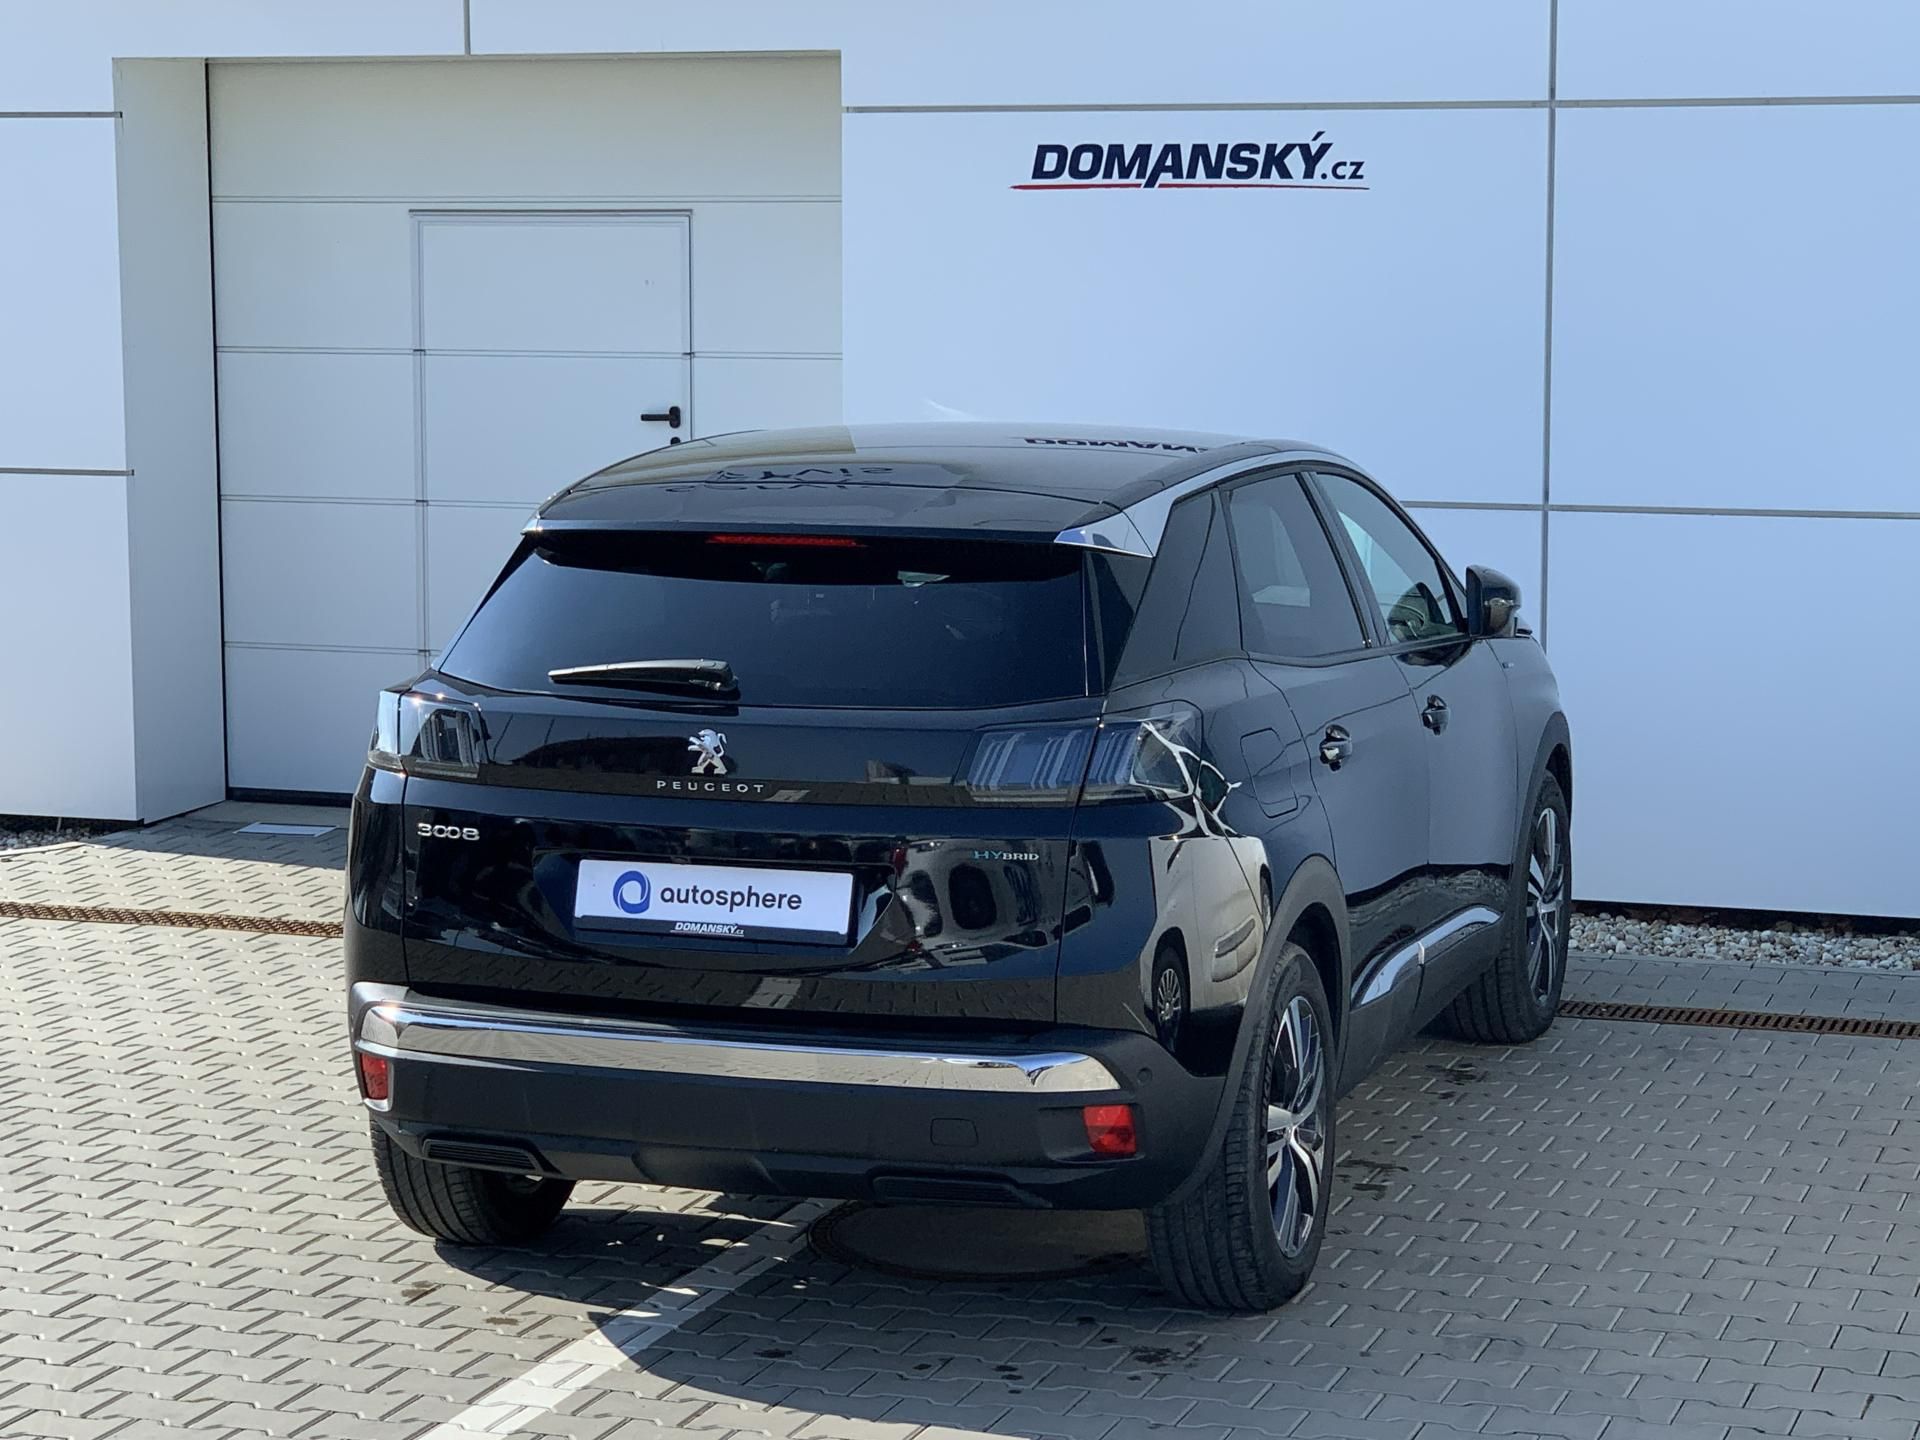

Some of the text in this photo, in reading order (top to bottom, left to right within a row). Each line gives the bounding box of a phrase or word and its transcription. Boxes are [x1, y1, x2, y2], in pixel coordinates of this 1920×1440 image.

[656, 780, 766, 794] PEUGEOT
[417, 822, 480, 841] 3008
[974, 850, 1040, 861] HYBRID
[660, 885, 802, 912] autosphere
